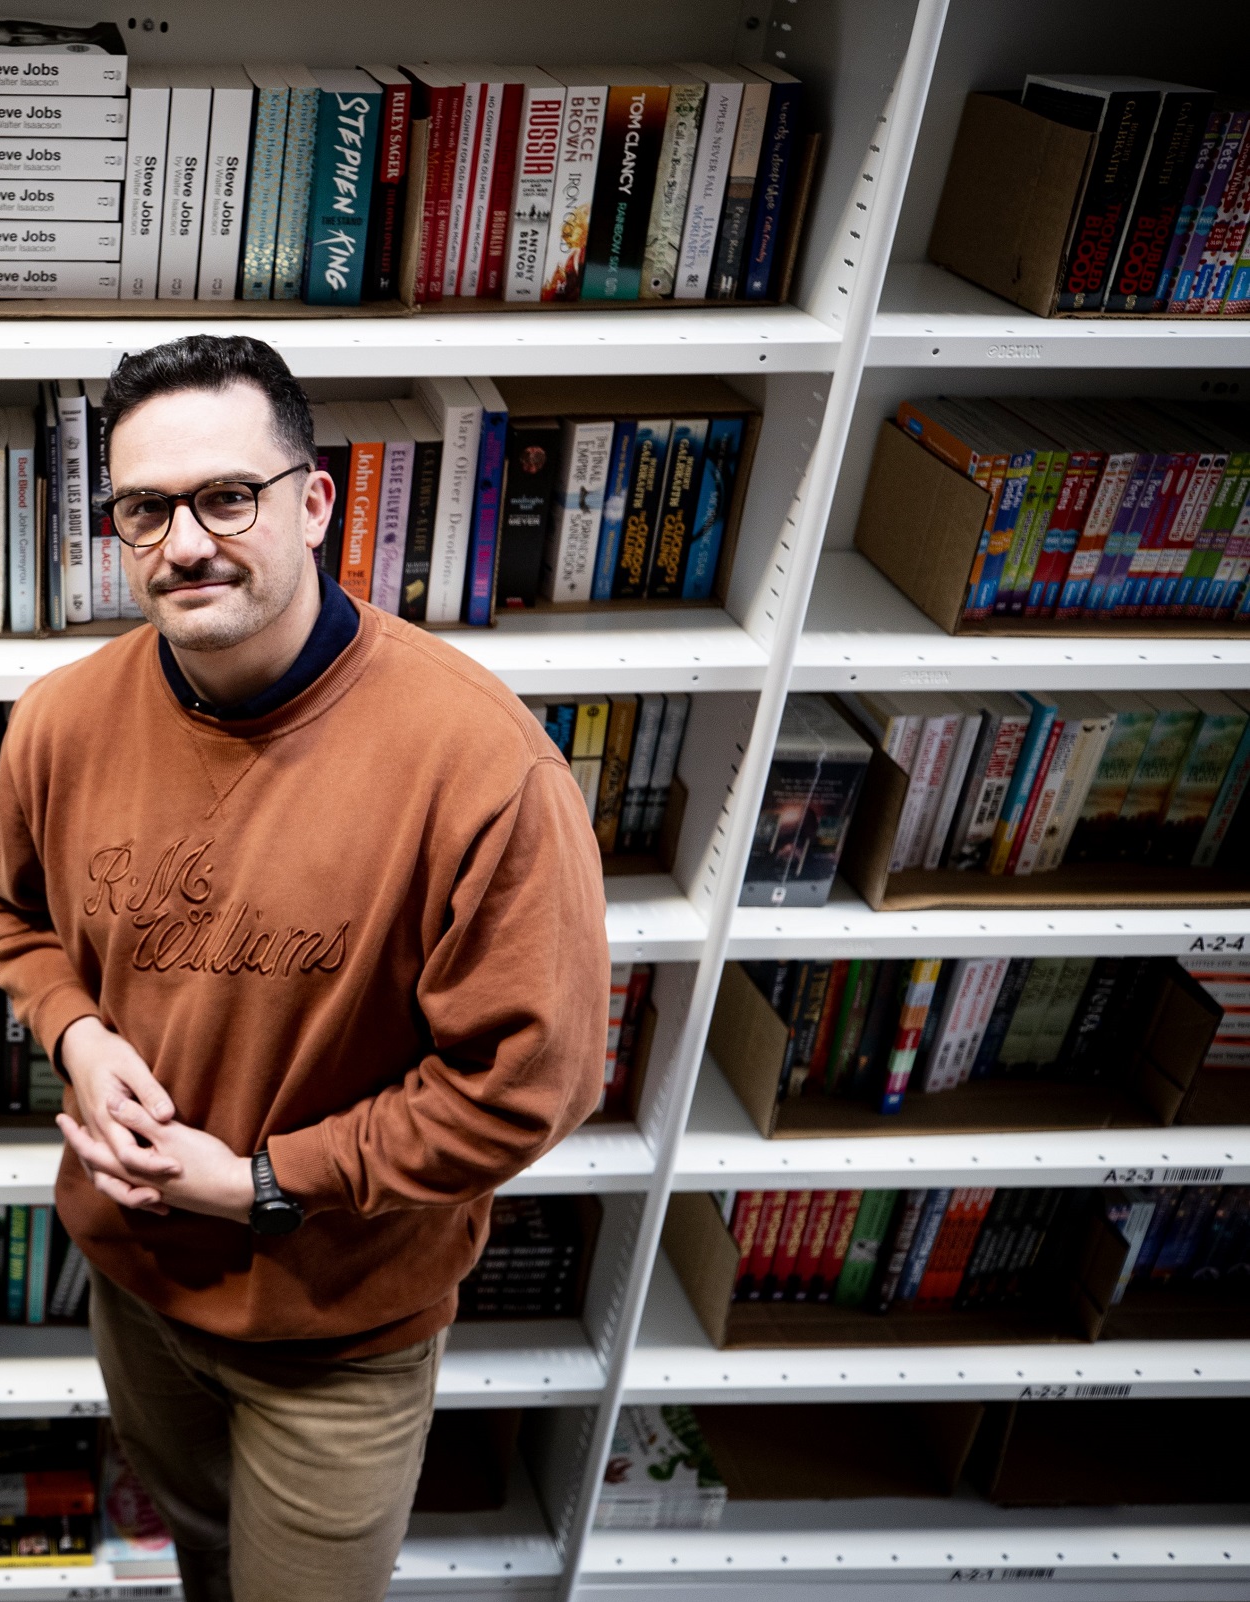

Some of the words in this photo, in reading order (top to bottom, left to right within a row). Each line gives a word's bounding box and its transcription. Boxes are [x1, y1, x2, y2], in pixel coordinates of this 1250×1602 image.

[20, 78, 59, 87] Isaacson
[23, 63, 59, 76] Jobs
[26, 106, 62, 119] Jobs
[390, 91, 406, 131] RILEY
[564, 97, 585, 162] BROWN
[580, 96, 600, 161] PIERCE
[626, 93, 646, 129] TOM
[26, 148, 61, 162] Jobs
[333, 92, 370, 214] STEPHEN
[523, 99, 562, 174] RUSSIA
[386, 133, 403, 179] SAGER
[619, 130, 640, 195] CLANCY
[1217, 141, 1239, 170] Pets
[19, 188, 54, 202] Jobs
[144, 157, 158, 197] Steve
[183, 157, 198, 197] Steve
[224, 157, 238, 197] Steve
[21, 230, 56, 243] Jobs
[140, 201, 155, 236] Jobs
[179, 201, 194, 237] Jobs
[220, 201, 235, 237] Jobs
[314, 229, 356, 291] KING
[516, 231, 528, 280] BEEVOR
[527, 229, 539, 282] ANTONY
[1068, 215, 1100, 294] BLOOD
[1120, 216, 1155, 294] BLOOD
[23, 270, 57, 283] Jobs
[457, 411, 474, 454] Mary
[18, 457, 28, 477] Bad
[68, 458, 81, 480] NINE
[358, 450, 374, 493] John
[389, 450, 406, 487] ELSIE
[452, 457, 469, 504] Oliver
[18, 479, 28, 508] Blood
[67, 484, 81, 504] LIES
[385, 490, 402, 528] SILVER
[19, 511, 30, 537] John
[69, 508, 82, 537] ABOUT
[348, 496, 371, 565] Grisham
[69, 540, 84, 566] WORK
[102, 539, 111, 572] BLACK
[442, 512, 463, 586] Devotions
[562, 513, 581, 581] SANDERSON
[576, 519, 593, 575] BRANDON
[102, 574, 111, 605] LOCH
[132, 901, 350, 979] Williams
[1190, 936, 1245, 952] A-2-4
[1104, 1169, 1155, 1184] A-2-3
[1021, 1386, 1067, 1398] A-2-2
